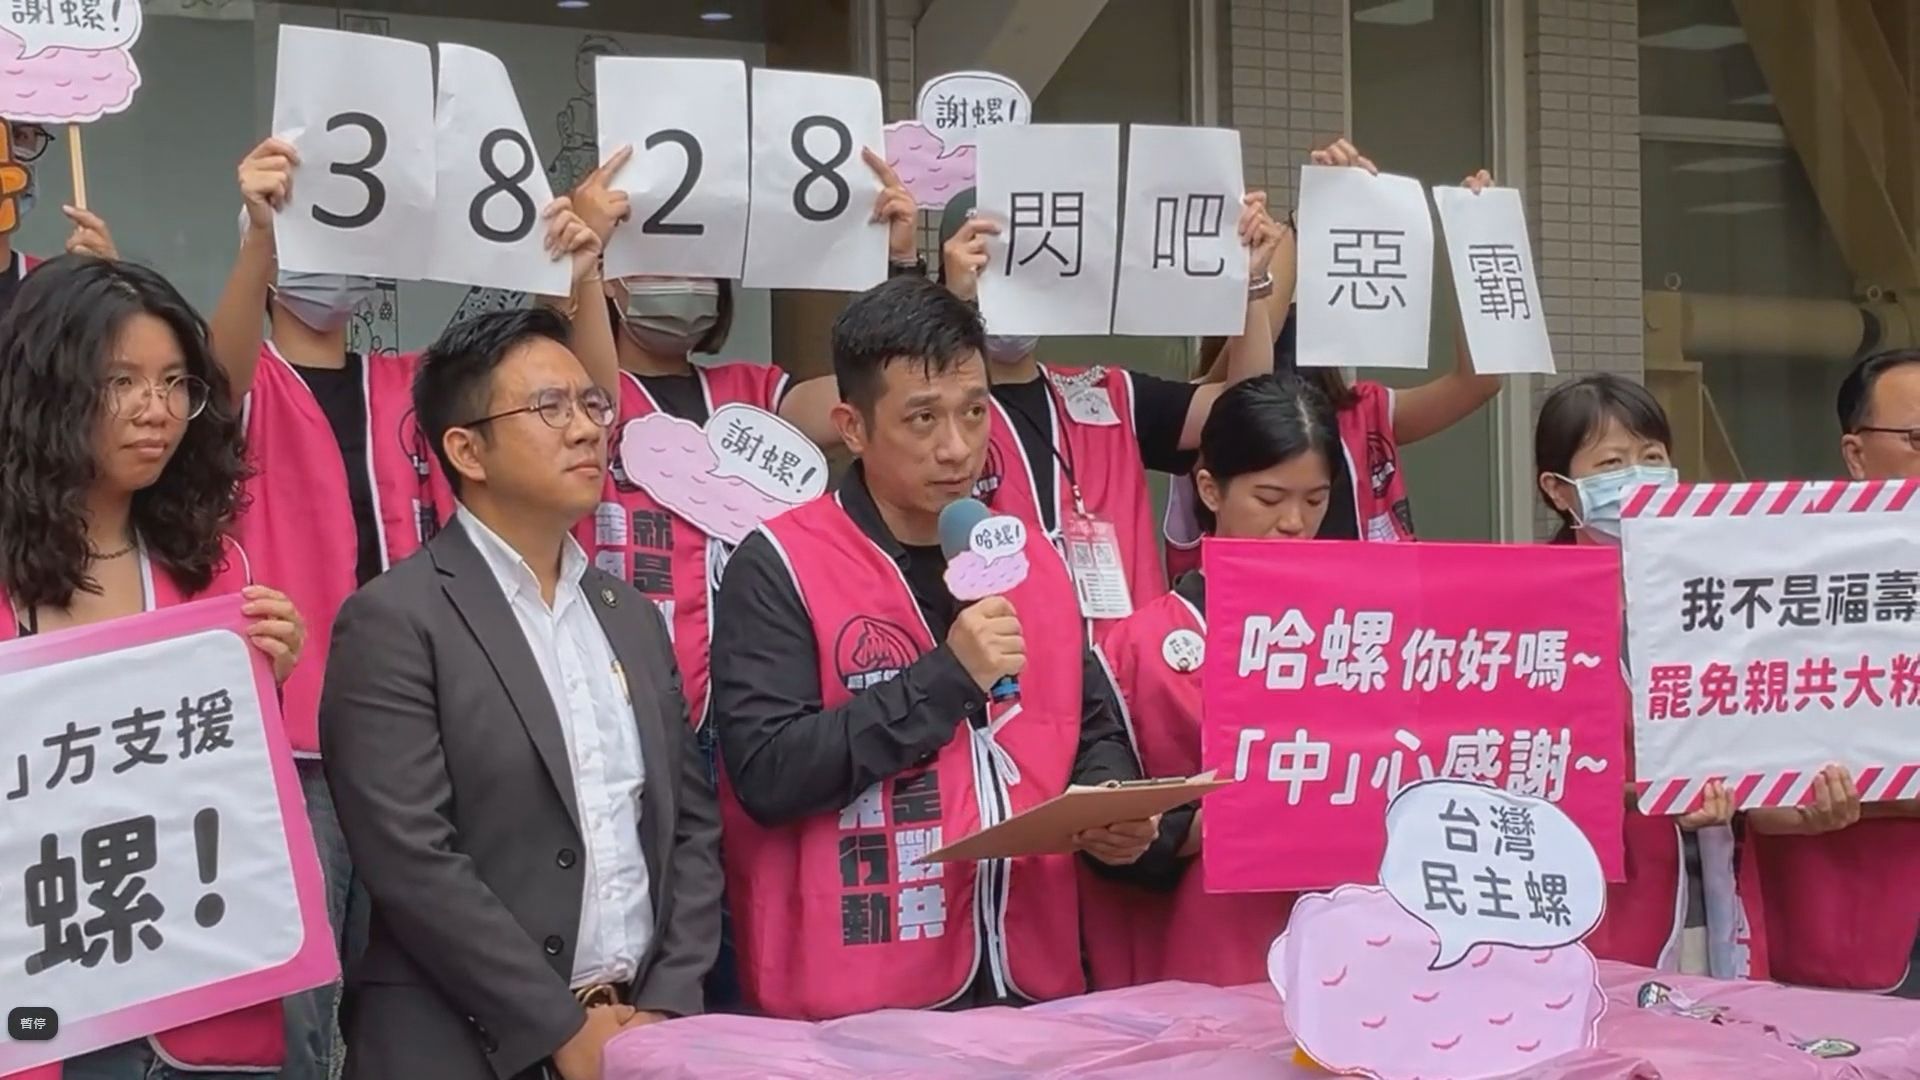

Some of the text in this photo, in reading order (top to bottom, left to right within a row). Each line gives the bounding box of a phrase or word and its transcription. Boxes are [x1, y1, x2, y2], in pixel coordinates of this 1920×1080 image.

[312, 112, 387, 228] 3
[469, 129, 537, 242] 8
[642, 130, 705, 235] 2
[791, 116, 853, 221] 8
[720, 418, 817, 494] 謝螺!
[1681, 570, 1919, 632] 我不是福壽
[1437, 800, 1536, 861] 台灣
[25, 807, 226, 975] 螺!
[1420, 860, 1572, 927] 民主螺
